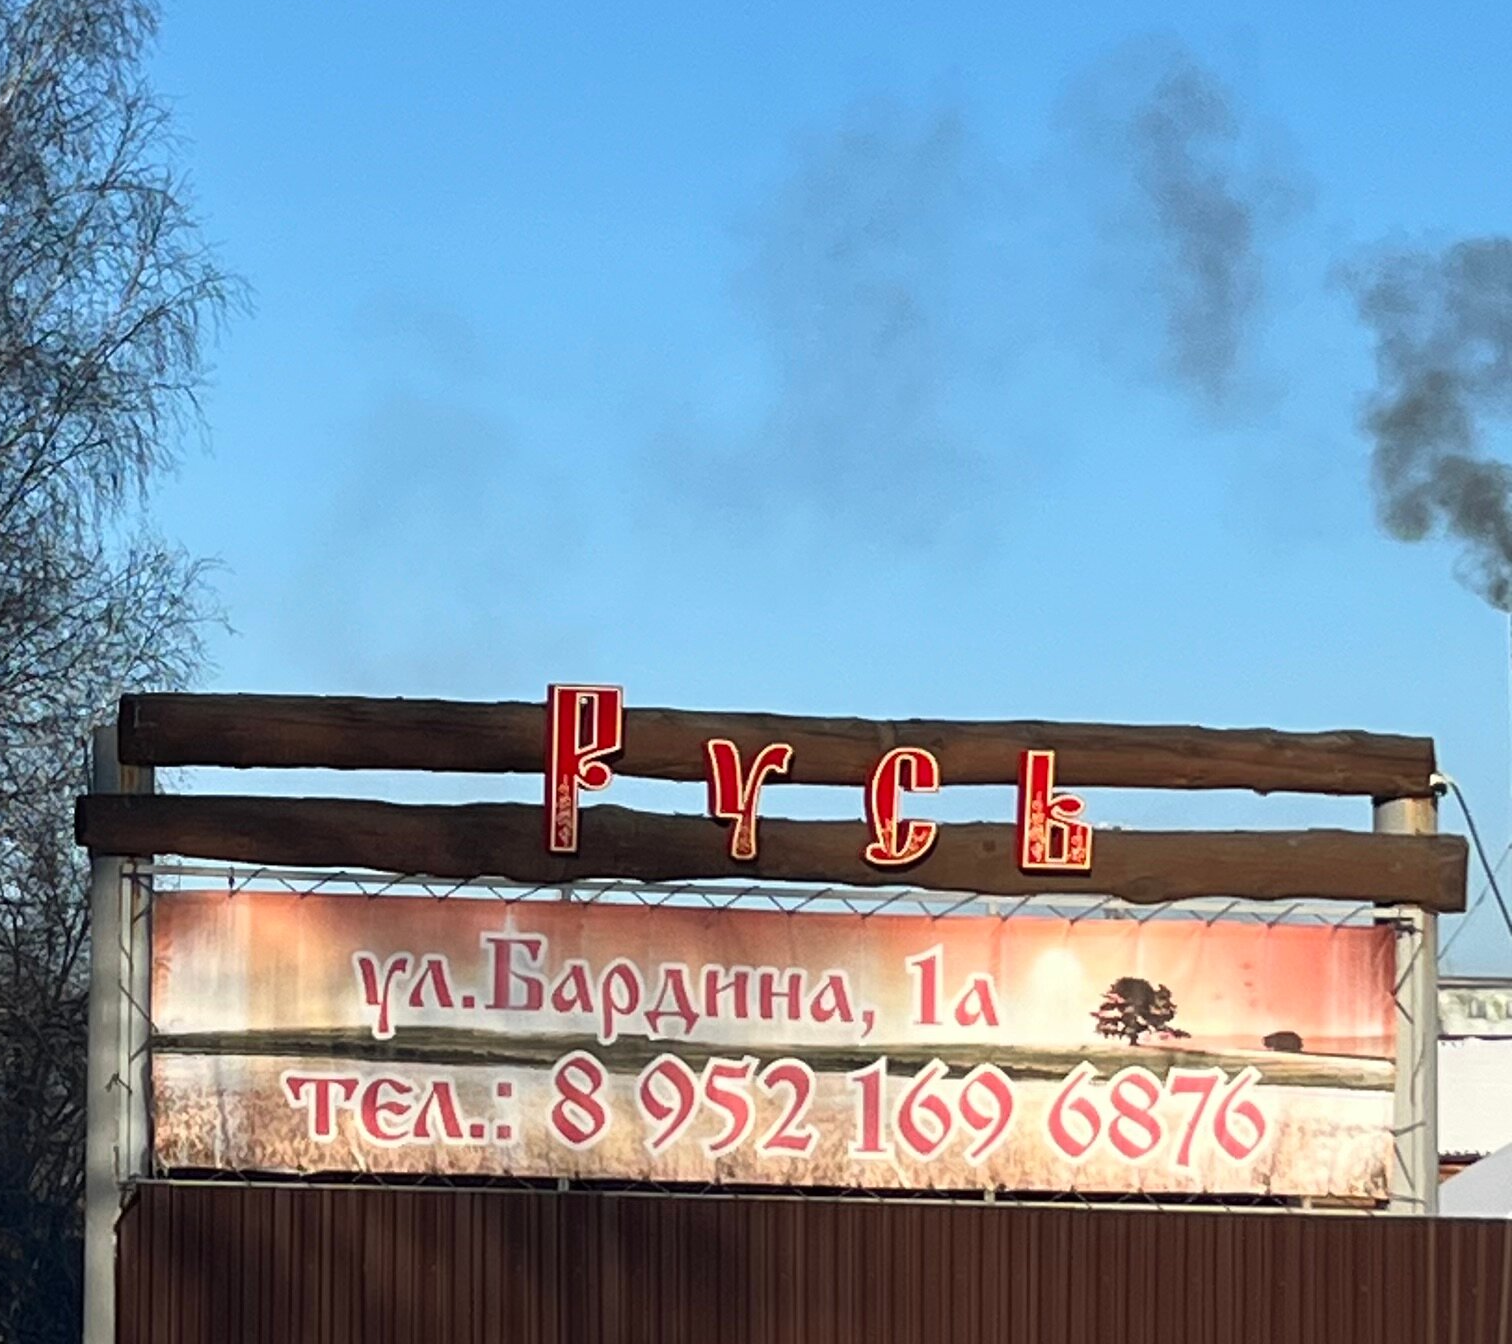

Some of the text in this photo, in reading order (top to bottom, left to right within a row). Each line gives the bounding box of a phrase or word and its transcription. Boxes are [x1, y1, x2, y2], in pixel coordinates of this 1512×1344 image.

[904, 946, 1001, 1029] 1а
[548, 1052, 608, 1148] 8
[637, 1053, 817, 1154] 952
[848, 1056, 1016, 1163] 169
[1046, 1061, 1271, 1171] 6876
